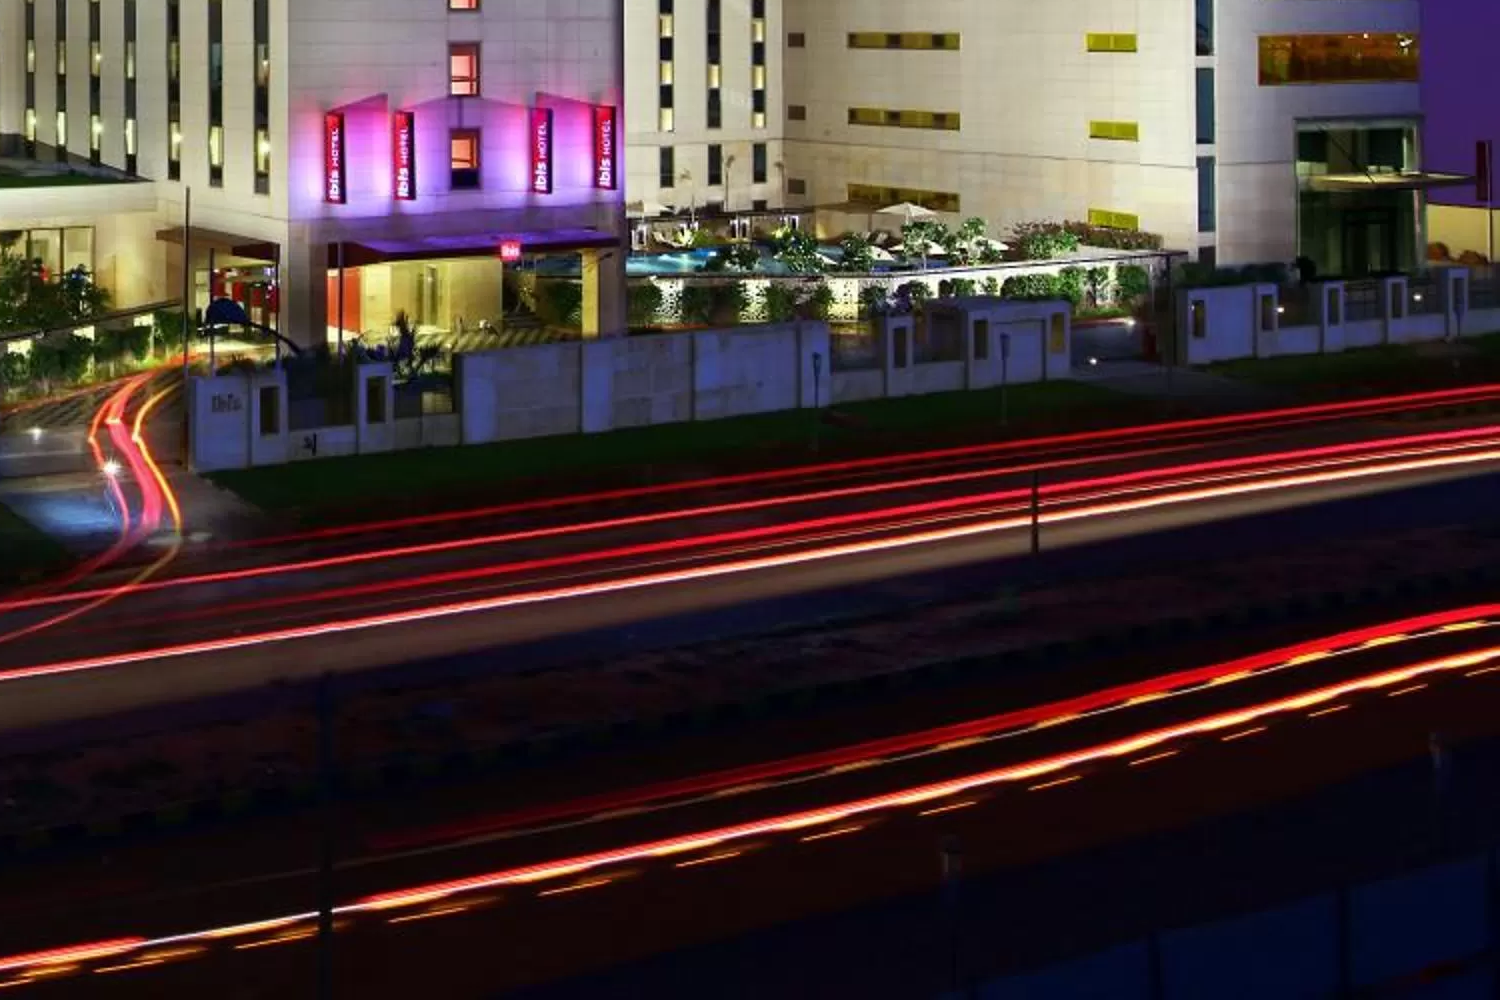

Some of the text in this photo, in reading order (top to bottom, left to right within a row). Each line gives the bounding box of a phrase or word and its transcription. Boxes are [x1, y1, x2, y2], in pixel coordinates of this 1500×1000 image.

[329, 127, 340, 200] ibis HOTEL
[534, 161, 547, 192] ibis
[598, 119, 611, 188] ibis HOTEL
[397, 167, 409, 198] ibis
